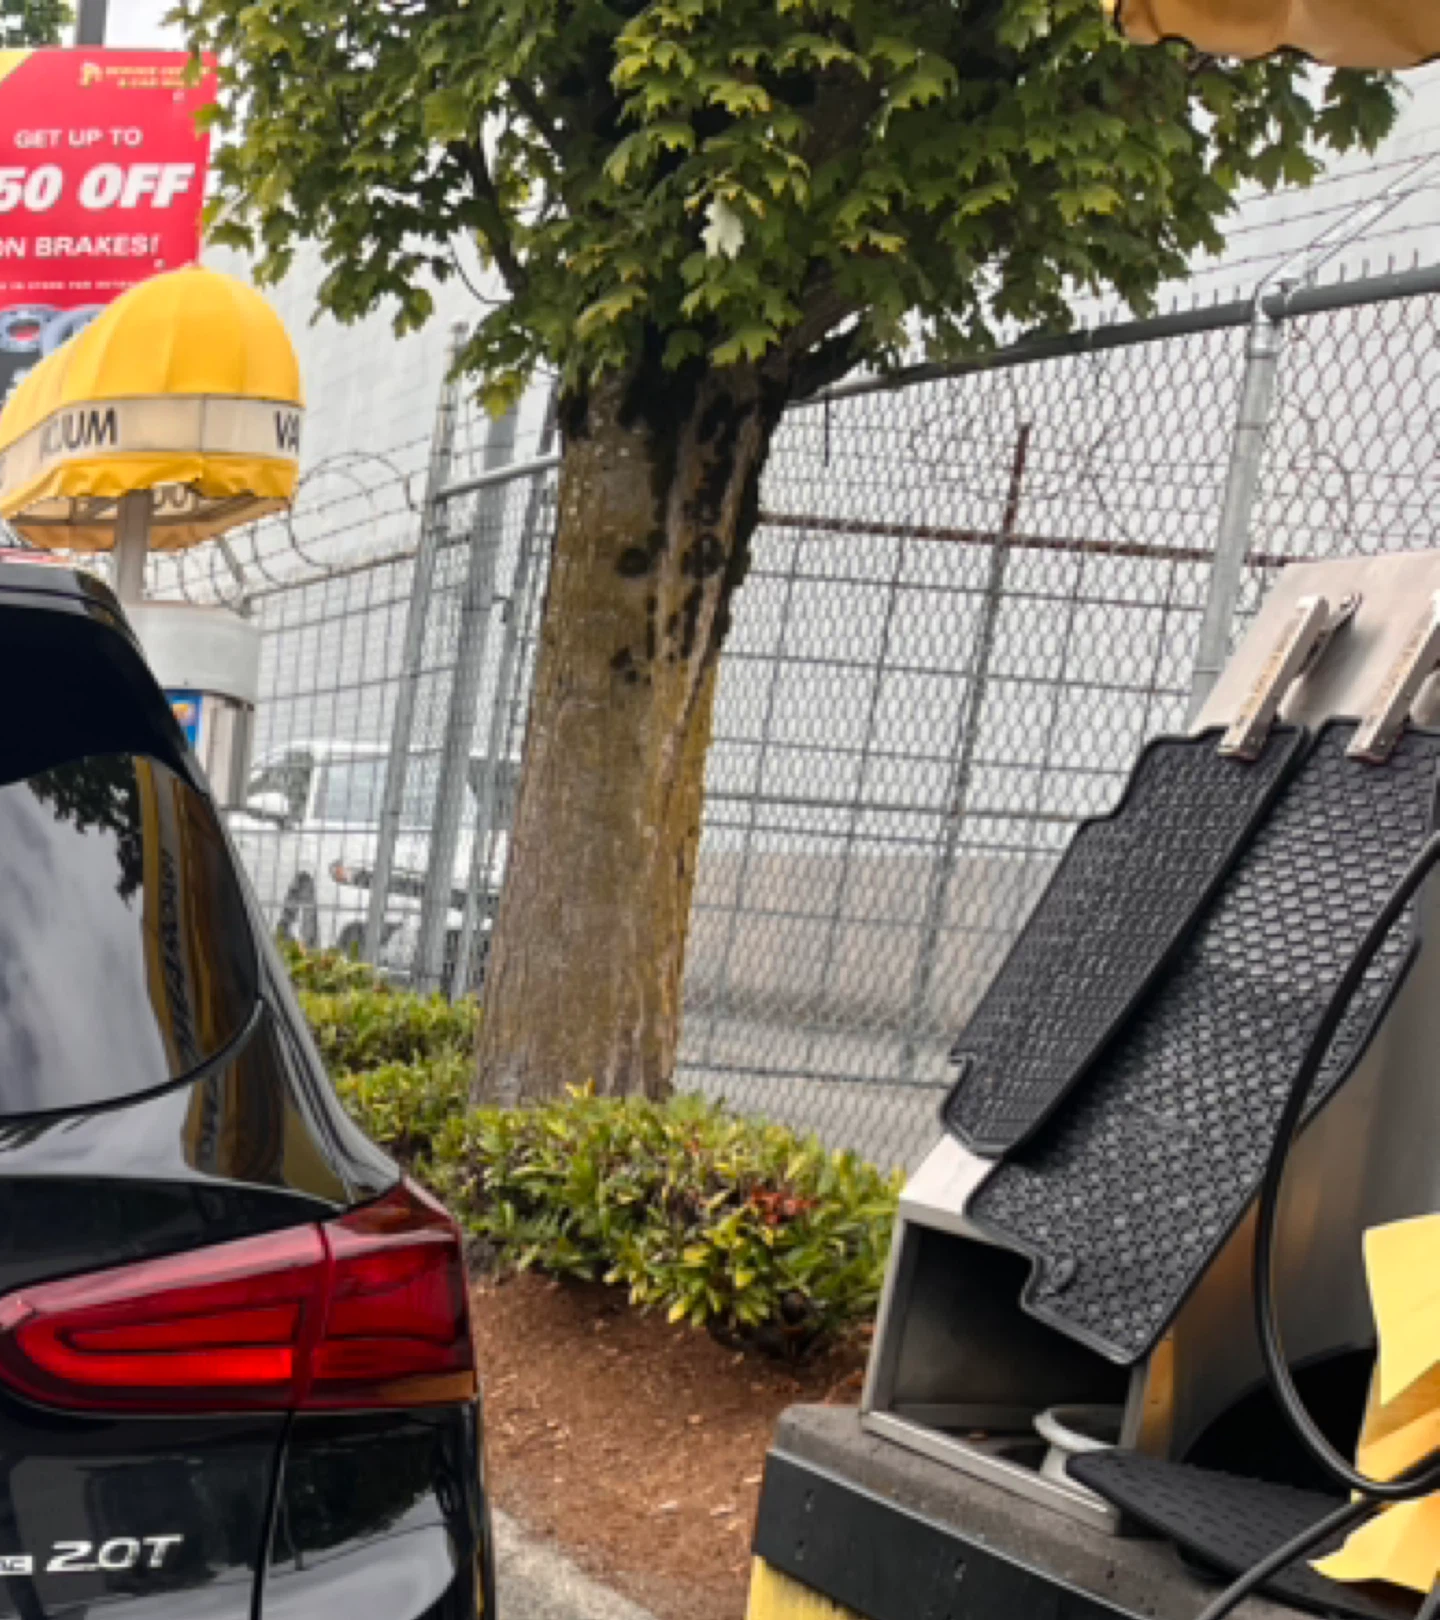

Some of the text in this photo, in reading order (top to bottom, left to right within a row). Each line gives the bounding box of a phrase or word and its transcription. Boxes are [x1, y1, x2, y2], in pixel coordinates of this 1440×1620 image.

[14, 126, 143, 148] GET UP TO
[77, 162, 195, 209] OFF
[35, 233, 160, 259] BRAKES!
